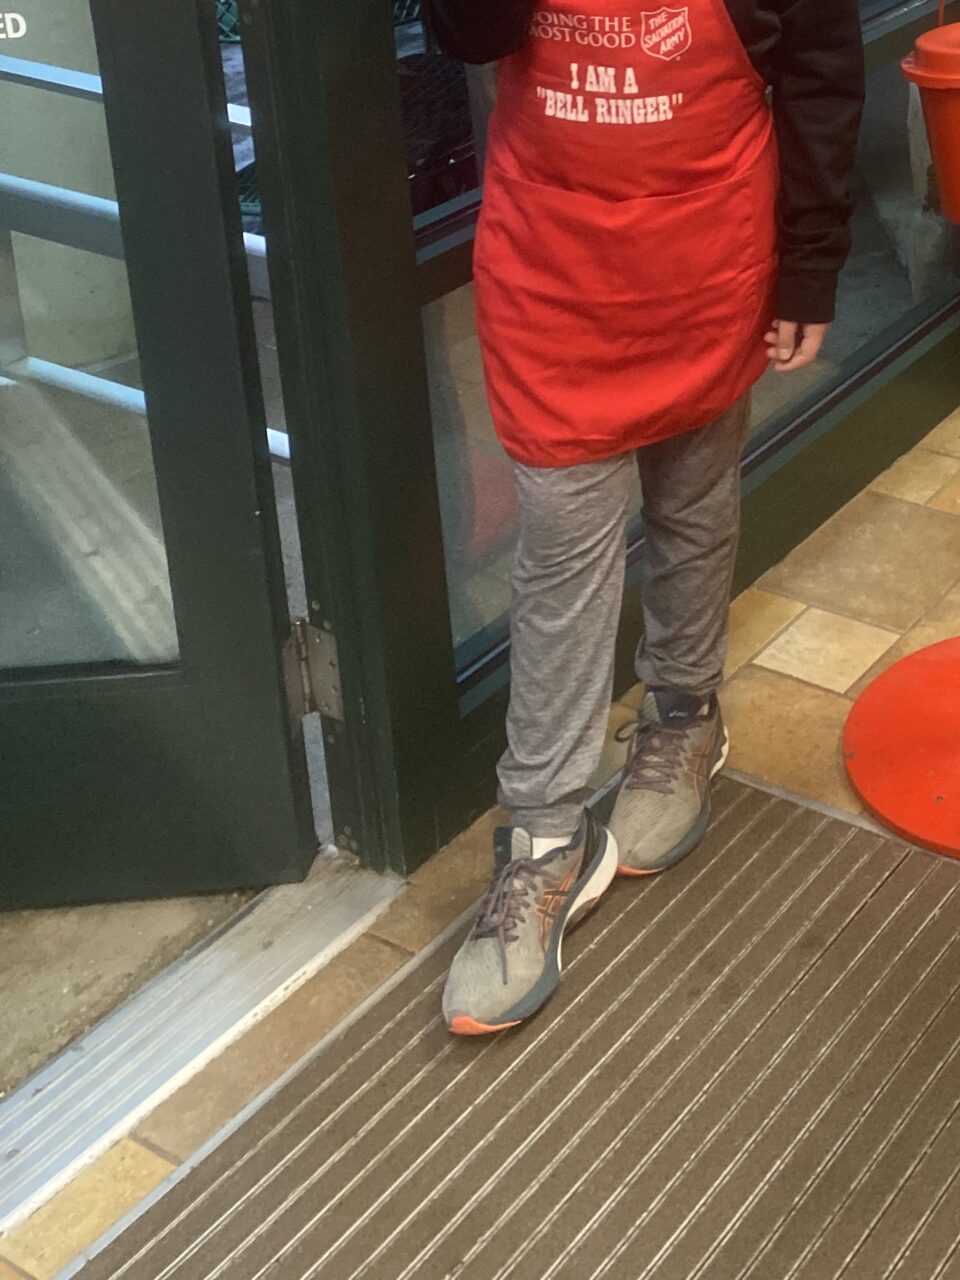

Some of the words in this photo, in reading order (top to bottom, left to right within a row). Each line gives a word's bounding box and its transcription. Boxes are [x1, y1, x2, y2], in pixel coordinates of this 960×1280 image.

[590, 16, 632, 32] THE
[644, 11, 685, 49] SALVATION
[648, 11, 668, 30] THE
[575, 30, 636, 48] GOOD
[660, 27, 685, 55] ARMY
[571, 63, 579, 89] I
[585, 65, 616, 94] AM
[623, 67, 639, 94] A
[537, 86, 589, 122] "BELL
[595, 93, 683, 124] RINGER"
